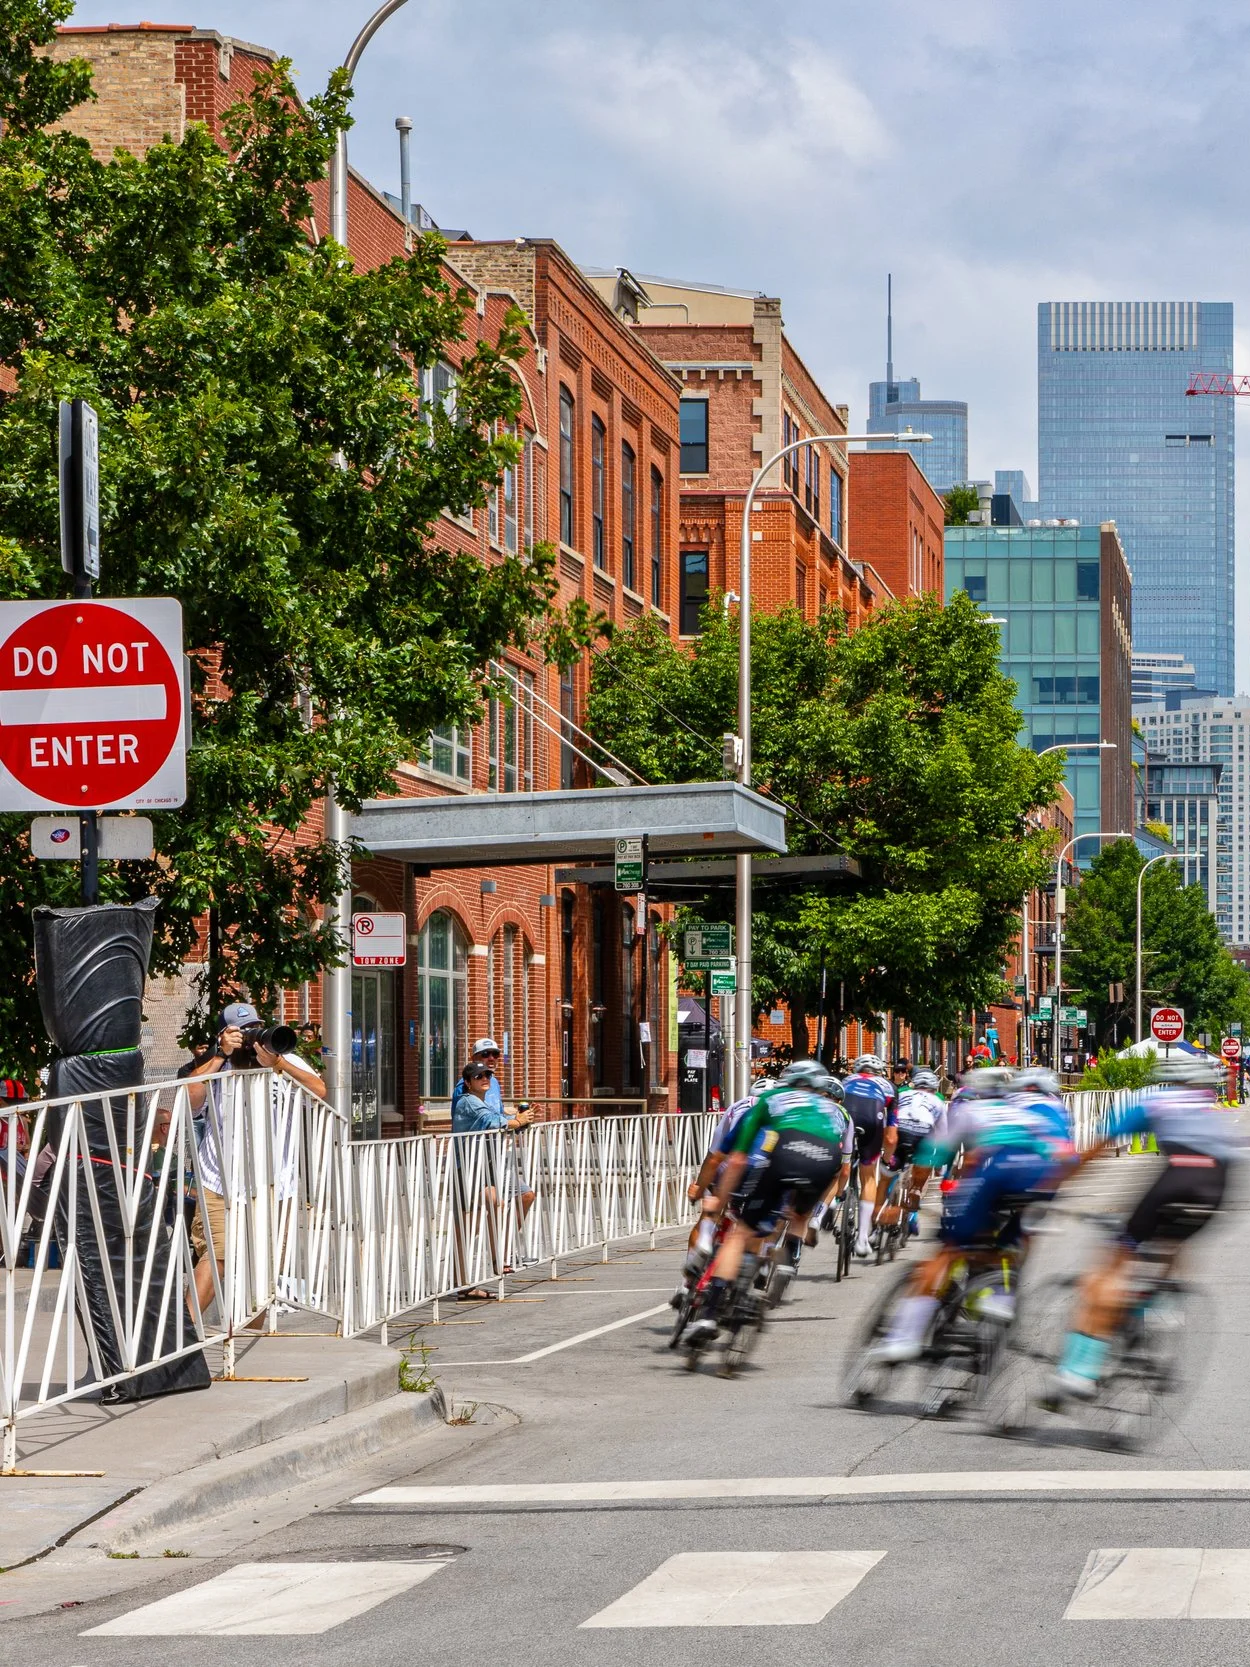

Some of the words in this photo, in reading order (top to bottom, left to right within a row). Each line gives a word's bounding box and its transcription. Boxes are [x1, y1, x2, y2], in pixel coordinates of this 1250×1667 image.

[13, 645, 58, 677] DO
[82, 641, 149, 674] NOT
[30, 733, 139, 767] ENTER
[360, 957, 376, 965] TOW
[379, 957, 399, 965] ZONE
